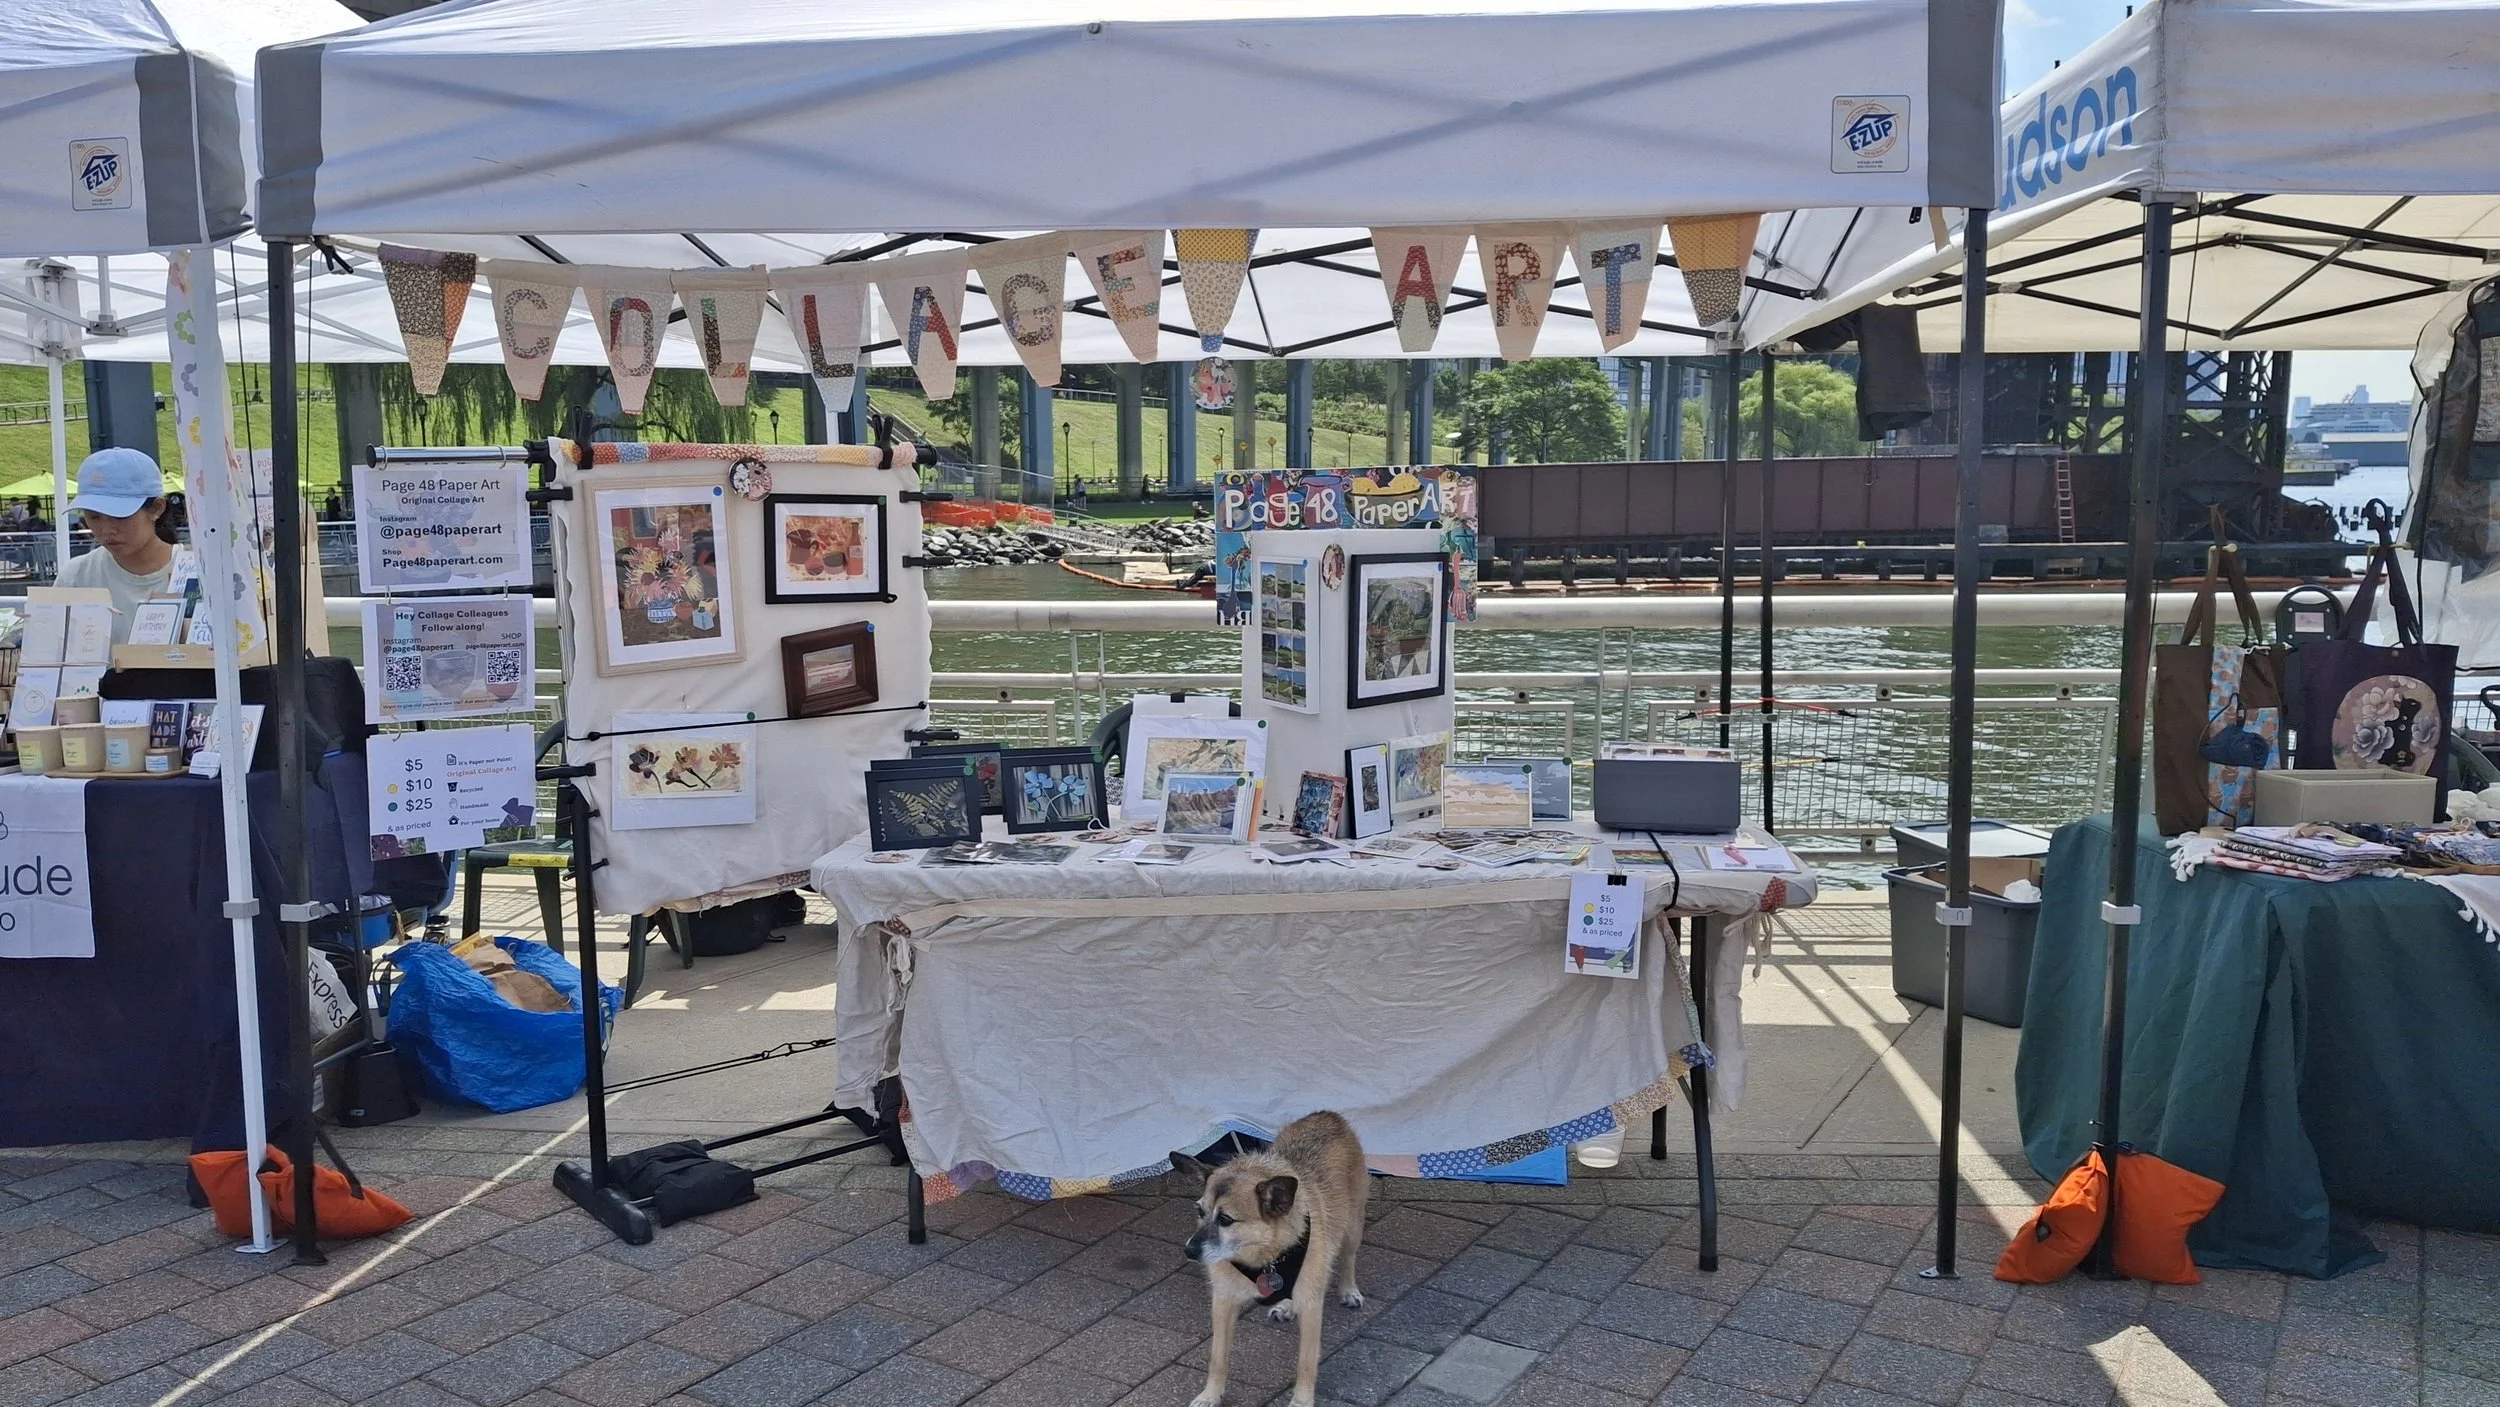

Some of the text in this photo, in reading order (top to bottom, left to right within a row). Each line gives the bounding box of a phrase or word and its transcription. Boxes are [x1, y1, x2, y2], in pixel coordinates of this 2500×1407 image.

[503, 242, 1642, 378] COLLAGE ART
[382, 479, 501, 494] Page 48 Paper Art
[401, 496, 436, 505] Original
[437, 496, 470, 505] Collage
[1224, 482, 1476, 528] Page 48 Paper ART
[379, 515, 417, 523] Instagram
[380, 523, 502, 539] @page48paperart
[383, 555, 503, 569] Page48paperart.com
[395, 609, 509, 622] Hey Collage Colleagues
[421, 623, 485, 633] Follow along!
[383, 637, 422, 646] Instagram
[501, 632, 522, 640] SHOP
[383, 643, 454, 654] @page48paperart
[465, 641, 525, 650] page48paperart.com
[405, 758, 423, 773] $5
[447, 769, 476, 777] Original
[477, 766, 504, 774] Collage
[405, 777, 432, 793] $10
[405, 797, 433, 813] $25
[387, 825, 394, 833] &
[406, 820, 432, 832] priced
[1600, 894, 1611, 903] $5
[1599, 905, 1615, 914] $10
[1598, 917, 1614, 926] $25
[1599, 929, 1623, 937] priced
[307, 960, 348, 1030] Express
